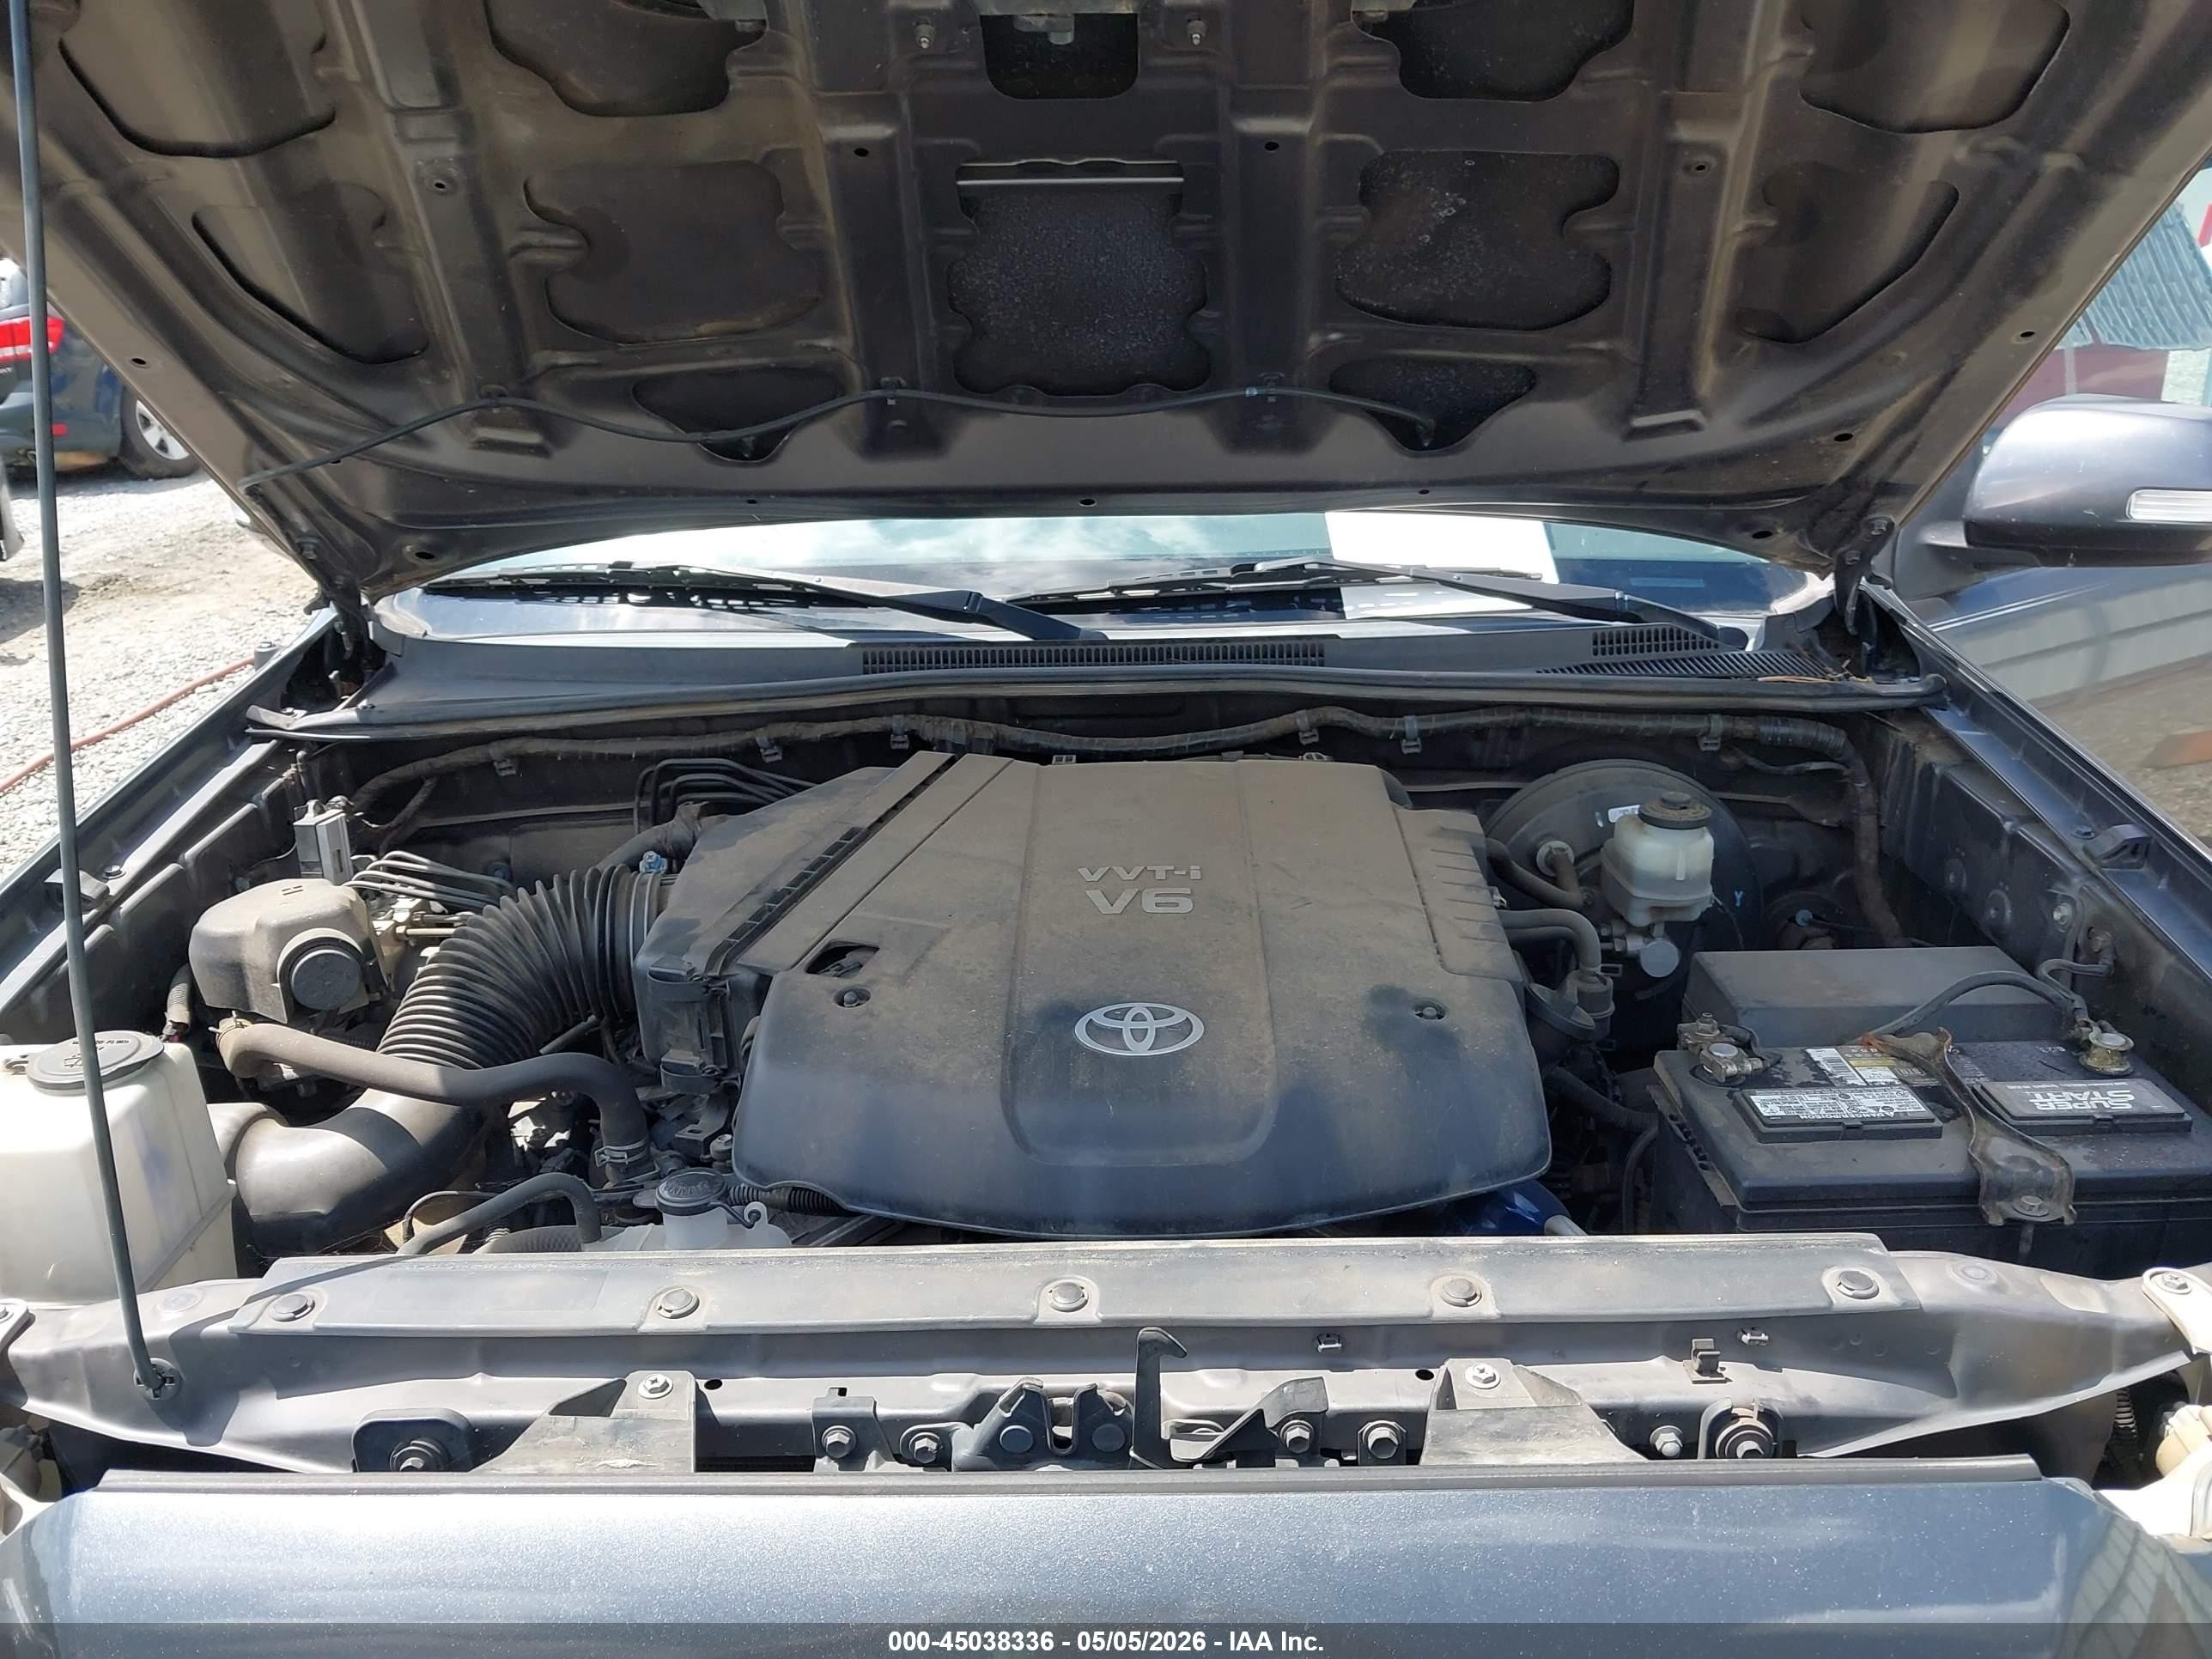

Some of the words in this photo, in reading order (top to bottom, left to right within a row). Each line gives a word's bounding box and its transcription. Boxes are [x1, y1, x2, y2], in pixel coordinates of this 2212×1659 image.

[1078, 865, 1202, 882] VVT-i
[1085, 888, 1194, 915] V6
[2028, 1090, 2136, 1102] START
[2033, 1100, 2134, 1110] SUPER
